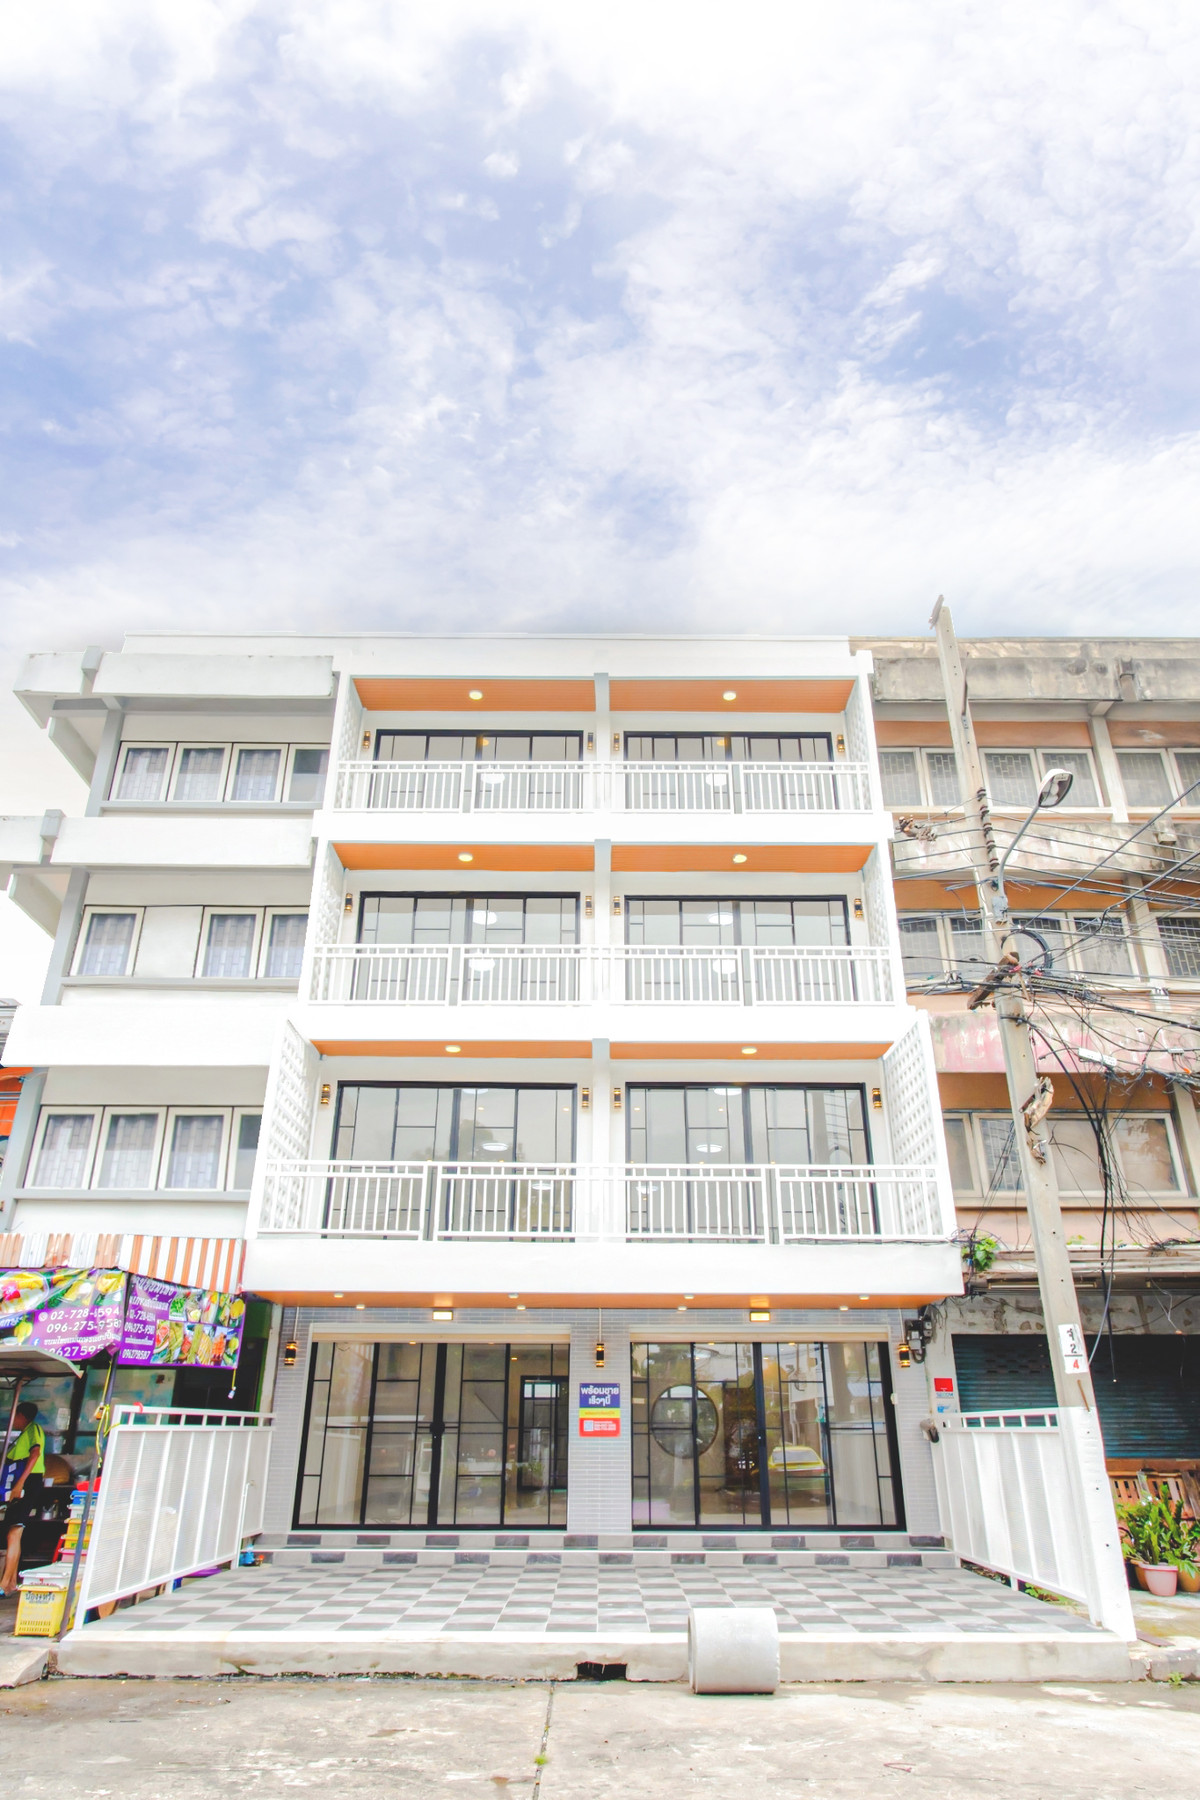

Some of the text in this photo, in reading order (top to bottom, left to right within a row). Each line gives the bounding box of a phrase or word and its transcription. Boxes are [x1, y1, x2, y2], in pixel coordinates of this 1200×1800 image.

[1070, 1343, 1077, 1354] 2
[1073, 1359, 1079, 1369] 4
[580, 1385, 619, 1395] พร้อมขาย
